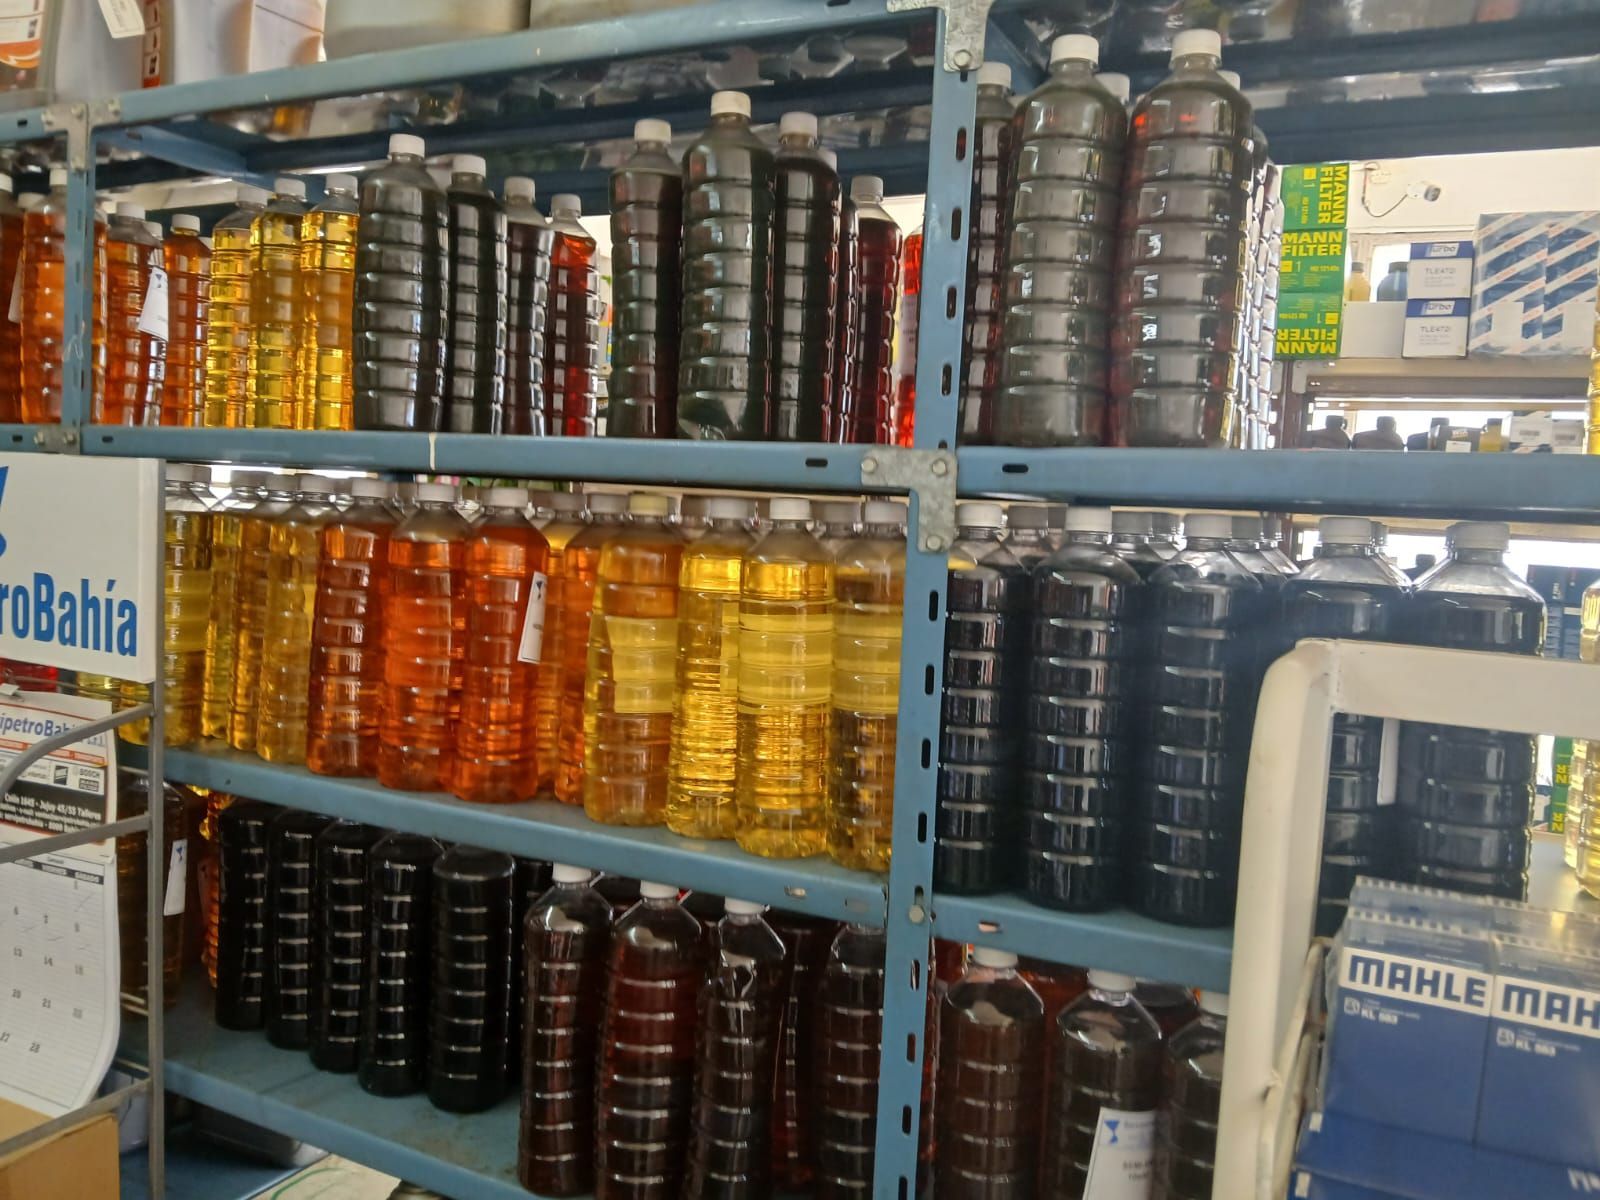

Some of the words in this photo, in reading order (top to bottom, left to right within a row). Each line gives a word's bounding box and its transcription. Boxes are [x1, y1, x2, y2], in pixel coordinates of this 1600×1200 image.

[1318, 167, 1333, 224] FILTER
[1332, 165, 1347, 224] MANN
[1281, 244, 1342, 257] FILTER
[1282, 231, 1343, 244] MANN
[1276, 341, 1336, 354] MANN
[1277, 328, 1337, 341] FILTER
[1349, 954, 1487, 1009] MAHLE
[1501, 983, 1600, 1030] MAH
